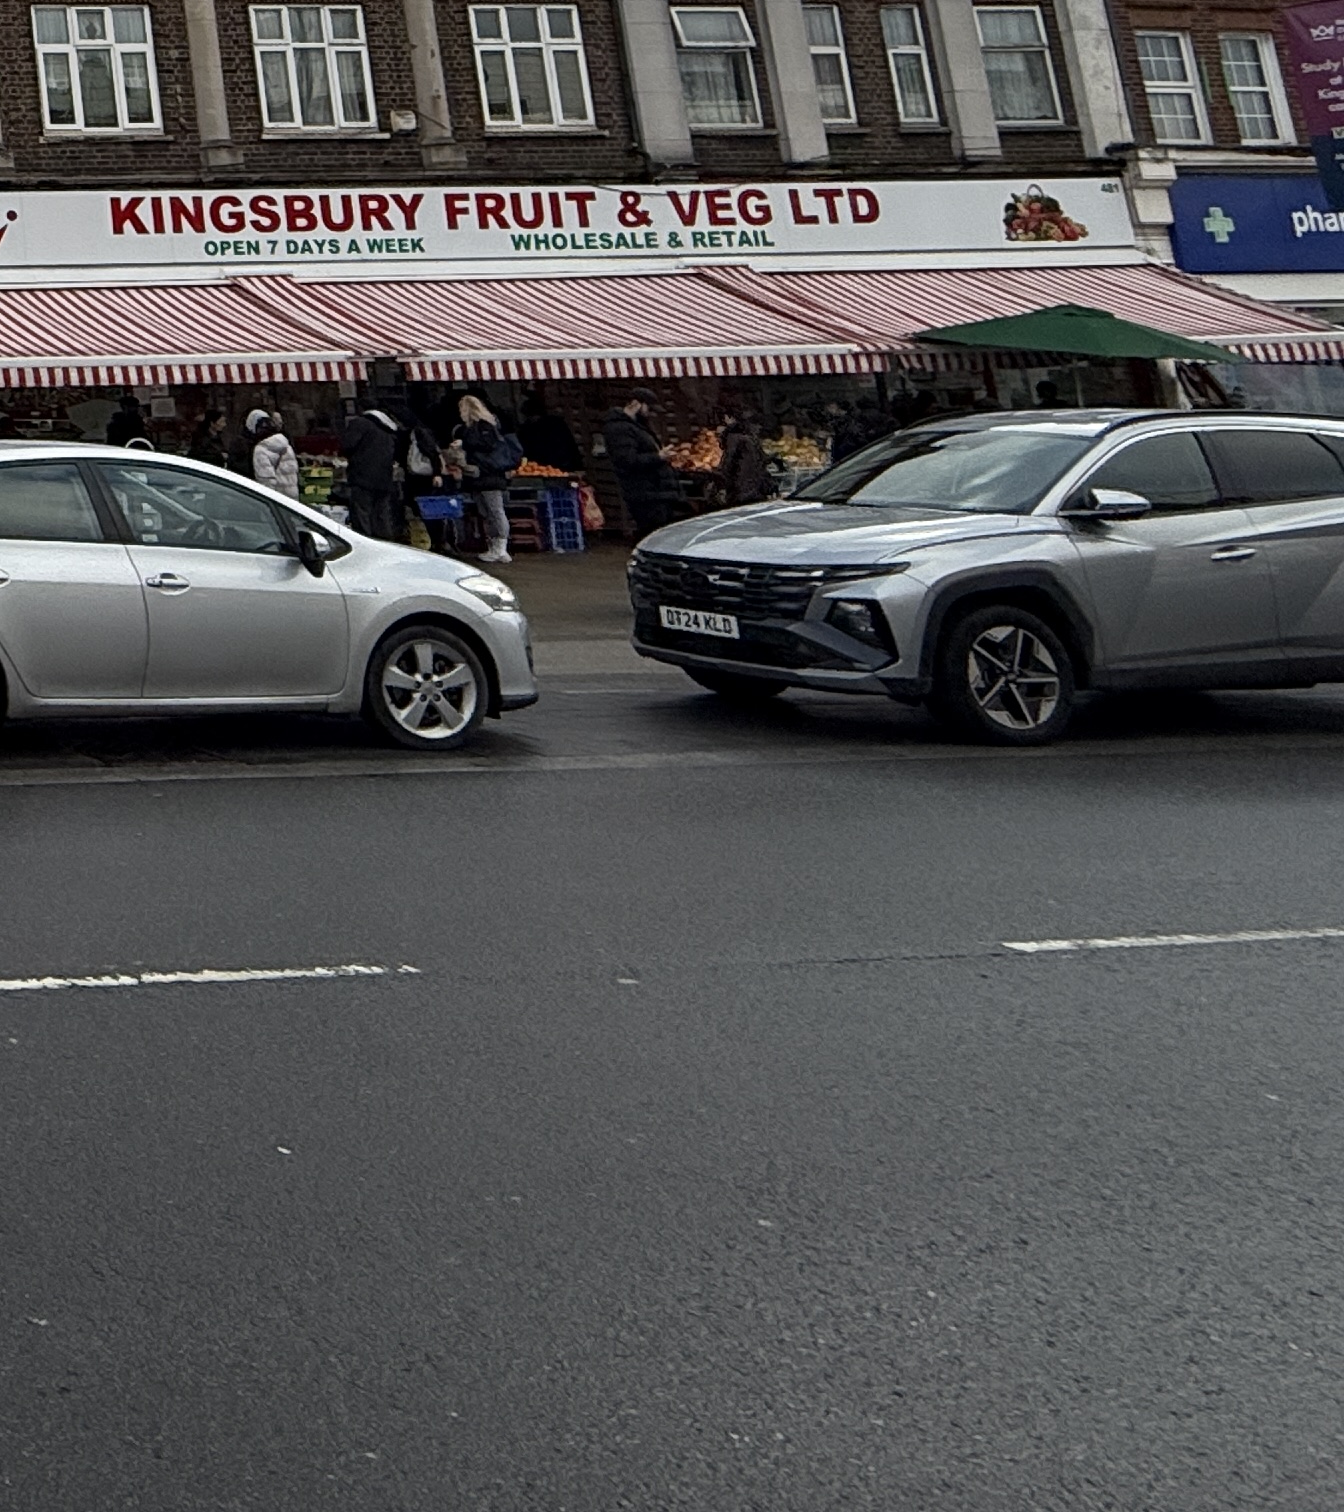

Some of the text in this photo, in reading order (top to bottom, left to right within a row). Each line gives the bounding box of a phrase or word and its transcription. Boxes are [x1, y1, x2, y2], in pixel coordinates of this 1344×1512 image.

[109, 188, 880, 235] KINGSBURY FRUIT & VEG LTD
[203, 237, 425, 256] OPEN 7 DAYS A WEEK
[511, 230, 775, 251] WHOLESALE & RETAIL
